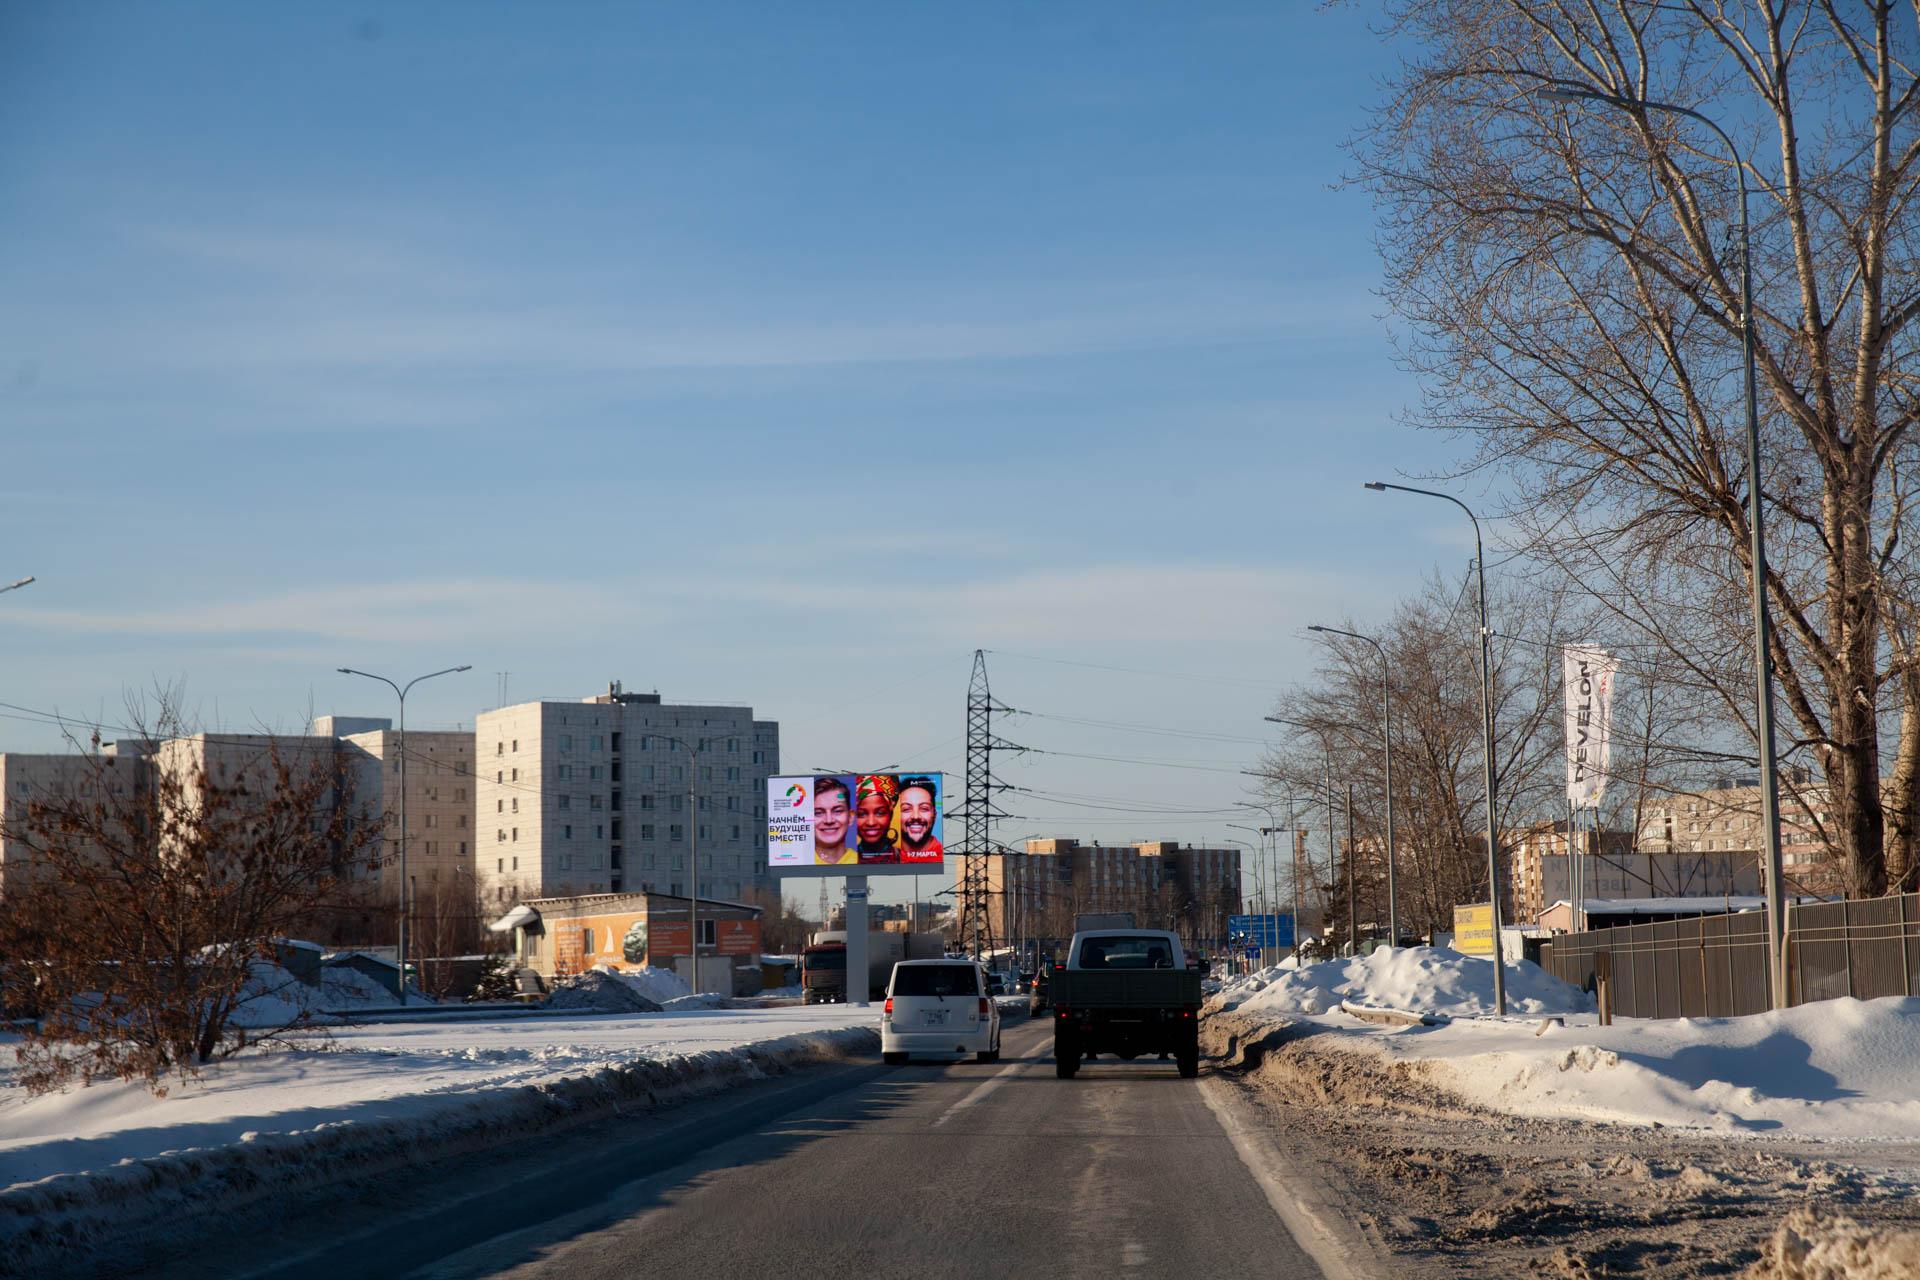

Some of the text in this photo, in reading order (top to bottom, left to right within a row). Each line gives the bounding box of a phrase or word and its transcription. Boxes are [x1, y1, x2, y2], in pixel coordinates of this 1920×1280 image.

[1574, 660, 1592, 783] DEVELON
[769, 815, 806, 823] НАЧНЁМ
[769, 825, 811, 833] БУДУЩЕЕ
[769, 834, 807, 842] ВМЕСТЕ!
